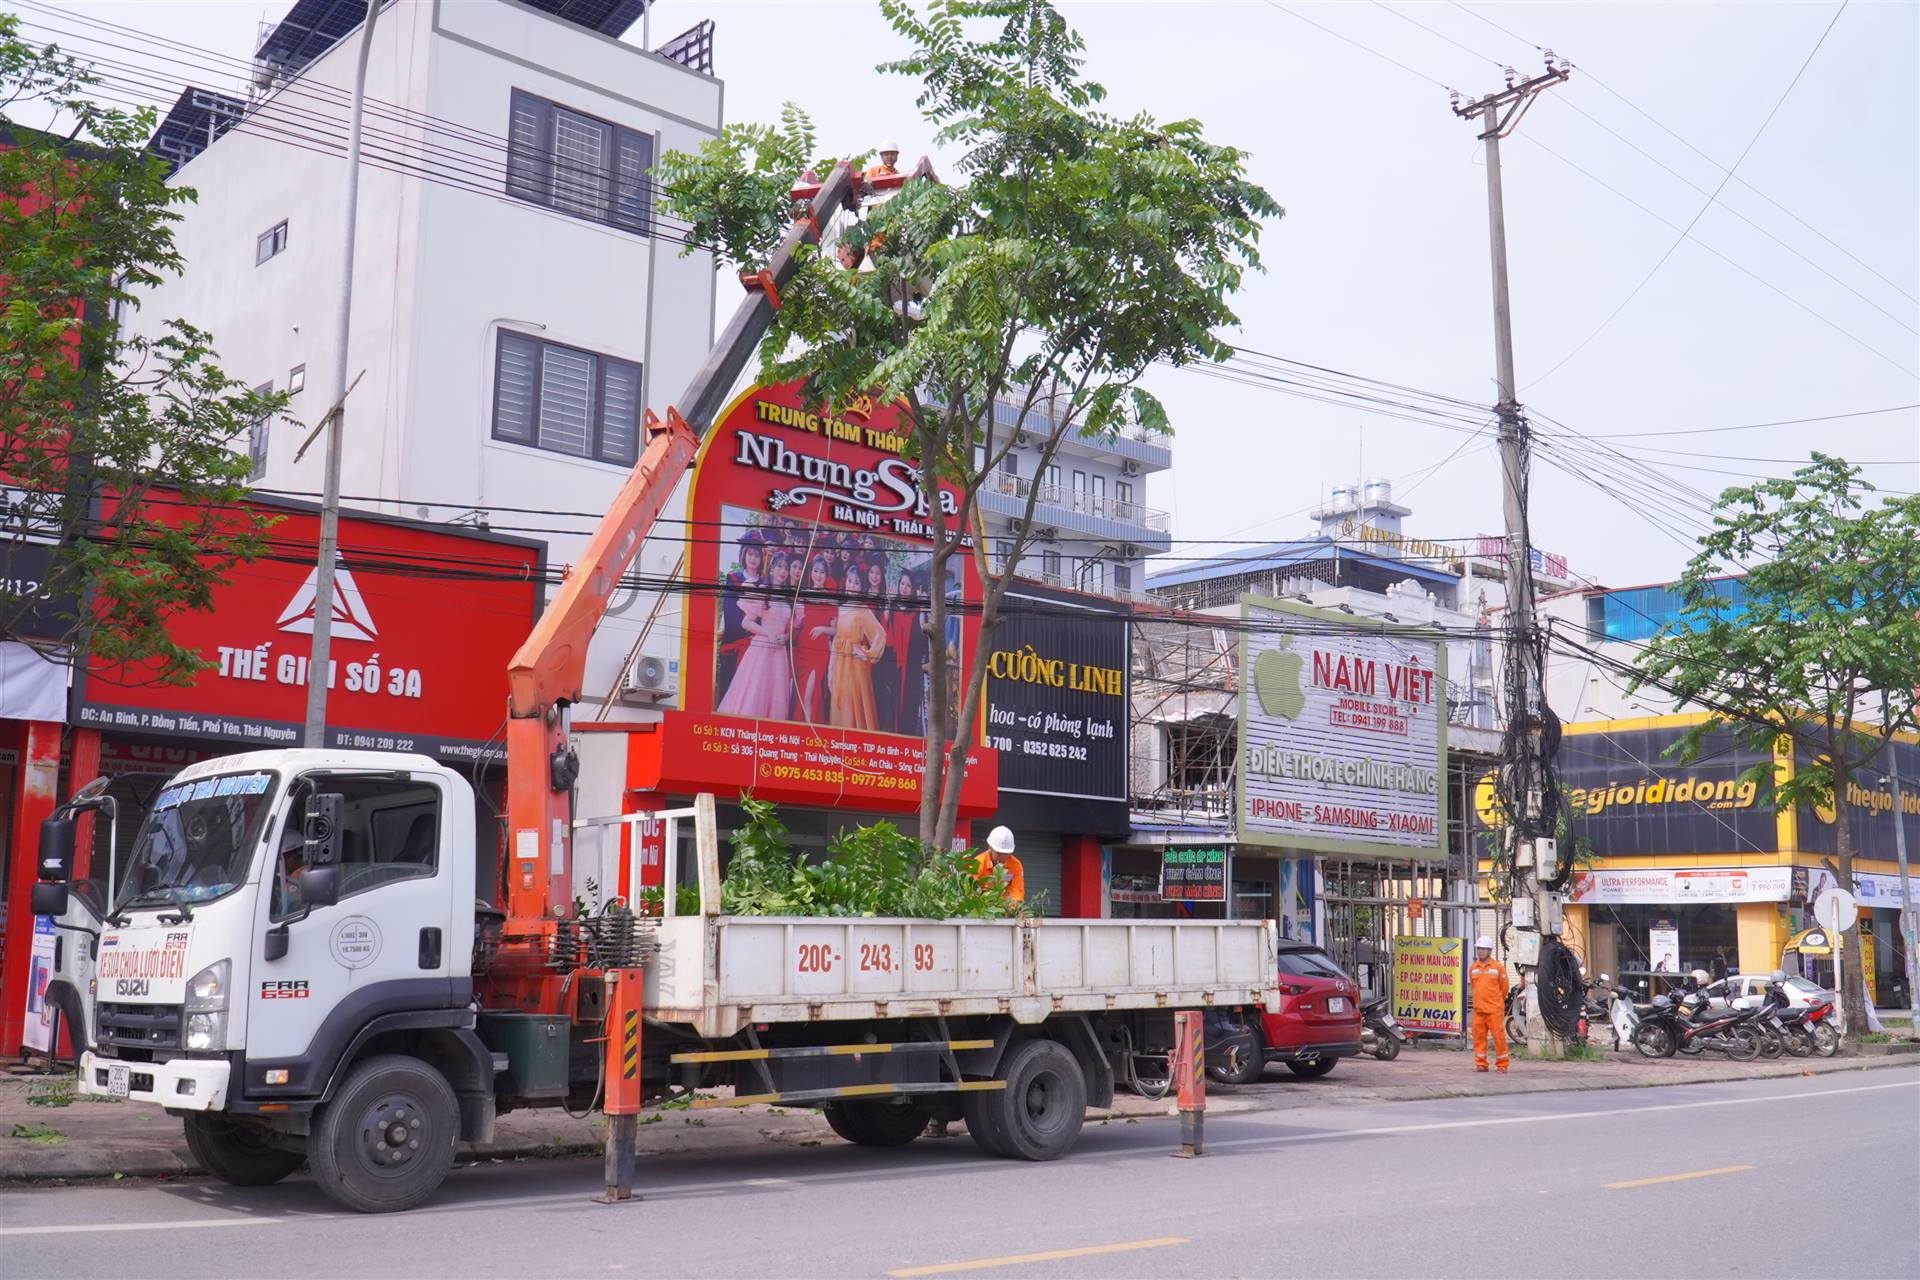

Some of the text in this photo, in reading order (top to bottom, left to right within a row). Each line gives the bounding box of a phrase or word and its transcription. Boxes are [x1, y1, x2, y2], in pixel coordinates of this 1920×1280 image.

[758, 401, 818, 431] TRUNG
[822, 418, 860, 442] TÂM
[834, 505, 853, 522] HÀ
[855, 511, 879, 528] NỘI
[894, 519, 923, 534] THÁI
[217, 642, 422, 698] THẾ GII SỐ 3A
[1068, 663, 1122, 696] LINH
[1312, 650, 1433, 714] NAM VIỆT
[1339, 698, 1398, 717] MOBILE STORE
[100, 710, 113, 723] An
[141, 714, 150, 727] P.
[152, 714, 176, 731] Đồng
[202, 718, 221, 734] Phố
[223, 722, 242, 737] Yên,
[244, 724, 262, 738] Thái
[263, 726, 297, 741] Nguyên
[989, 703, 1016, 726] hoa
[1043, 712, 1082, 739] phòng
[1086, 717, 1114, 740] lạnh
[1333, 710, 1350, 723] TEL:
[1388, 718, 1405, 732] 888
[354, 735, 375, 748] 0941
[377, 737, 394, 750] 209
[397, 739, 414, 751] 222
[993, 737, 1012, 752] 700
[1023, 740, 1048, 757] 0352
[1049, 743, 1068, 759] 625
[1068, 746, 1087, 761] 242
[774, 766, 917, 790] 0975 453 835 0977 269 868
[1250, 743, 1287, 781] ĐIỆN
[1292, 753, 1341, 788] THOẠI
[1343, 756, 1390, 789] CHÍNH
[214, 771, 272, 797] NGUYÊN
[1252, 798, 1433, 834] IPHONE SAMSUNG XIAOMI
[1601, 878, 1620, 887] ULTRA
[160, 949, 185, 984] ĐIỆN
[914, 944, 934, 971] 93
[116, 978, 149, 995] ISUZU
[261, 989, 310, 999] 650
[262, 980, 309, 989] FRR
[1400, 989, 1410, 1001] FIX
[1398, 1003, 1456, 1021] LẤY NGAY
